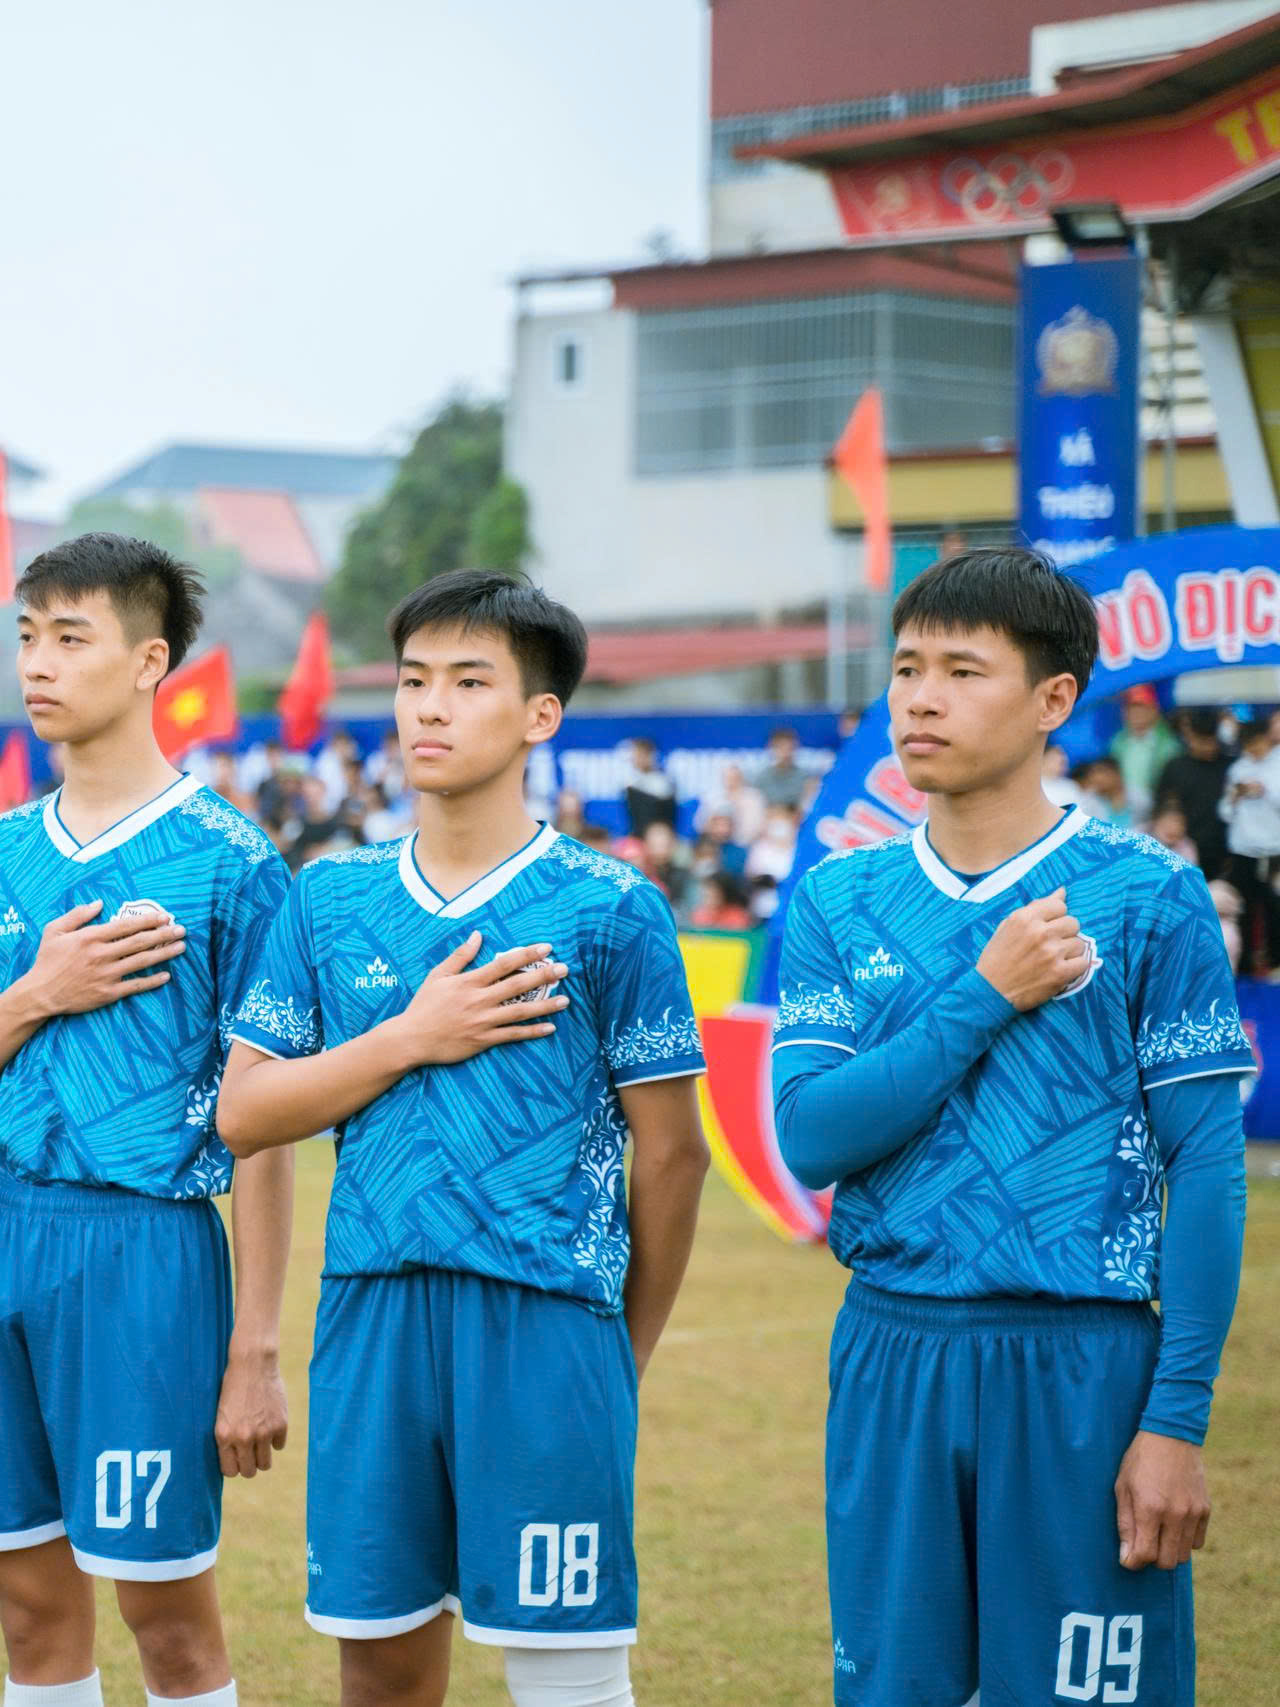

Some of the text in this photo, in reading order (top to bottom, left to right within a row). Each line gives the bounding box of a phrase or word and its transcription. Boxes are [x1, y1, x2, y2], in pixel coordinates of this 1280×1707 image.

[1180, 568, 1280, 662] ĐỊC
[354, 974, 398, 989] ALPHA
[854, 963, 904, 981] ALPHA
[96, 1450, 171, 1529] 07
[519, 1523, 599, 1607] 08
[1055, 1612, 1143, 1703] 09
